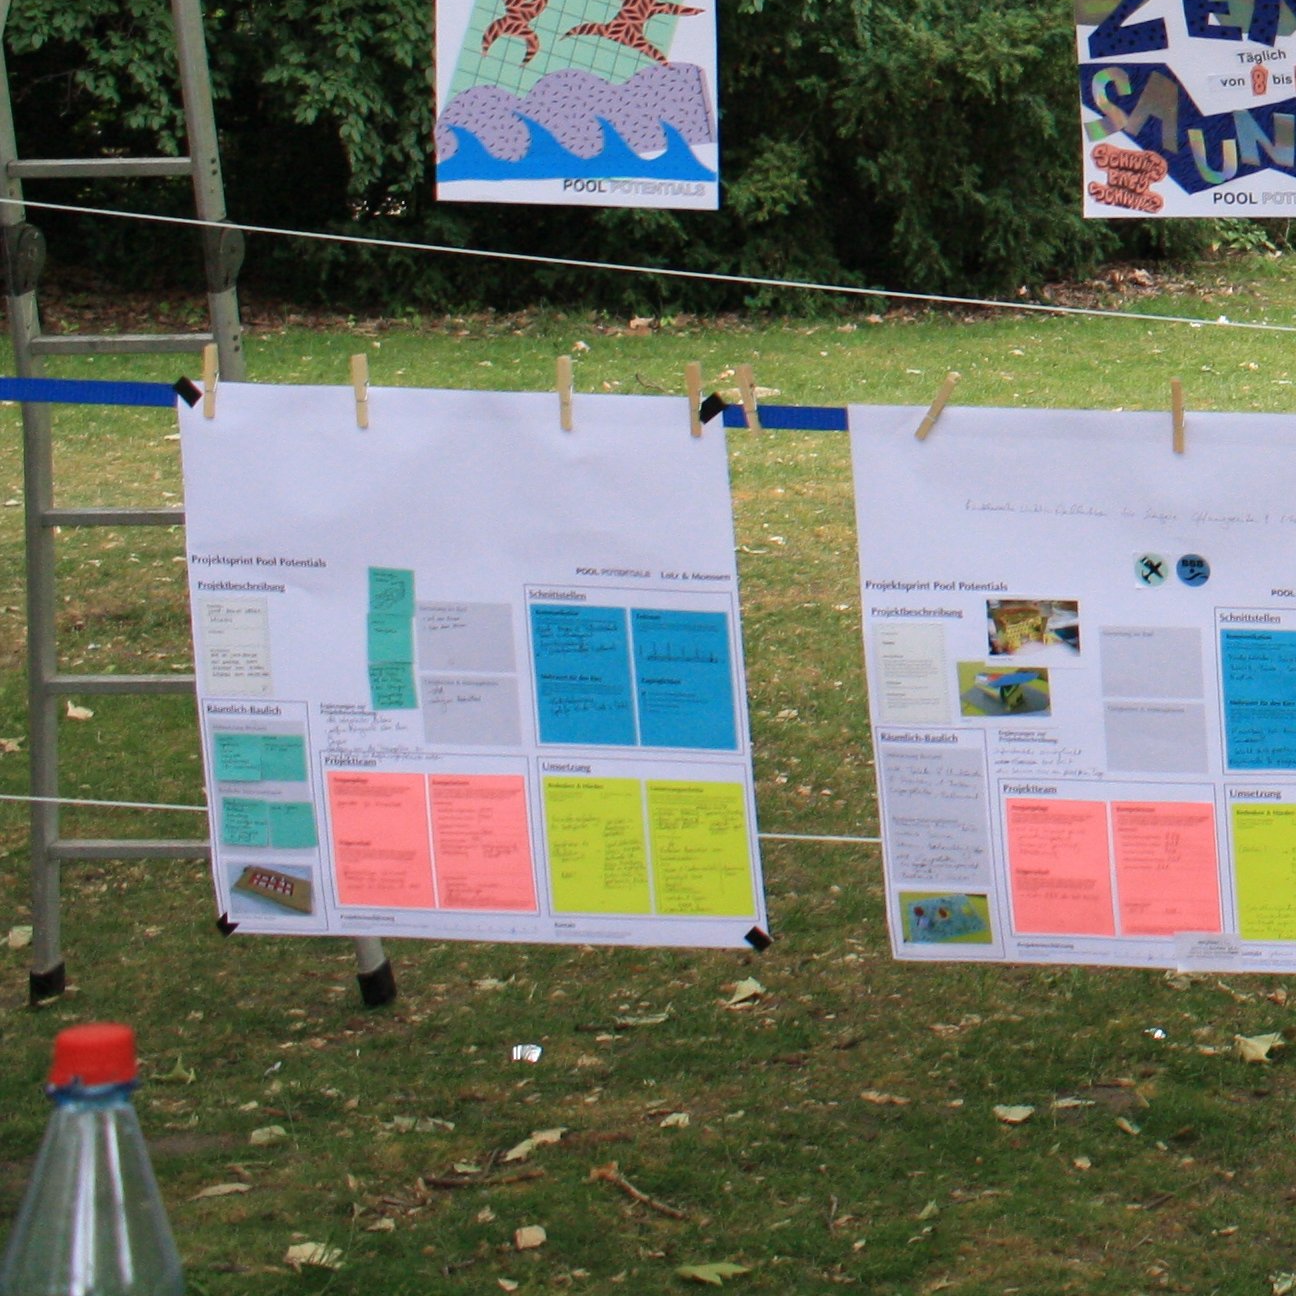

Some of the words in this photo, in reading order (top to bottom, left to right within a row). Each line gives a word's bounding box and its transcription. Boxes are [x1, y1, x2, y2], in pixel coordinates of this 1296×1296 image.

[1238, 49, 1287, 64] Täglich
[1220, 77, 1245, 88] von
[1251, 66, 1267, 95] 8
[1272, 71, 1292, 86] bis
[563, 179, 606, 194] POOL
[608, 181, 706, 197] POTENTIALS
[1213, 192, 1257, 204] POOL
[865, 580, 930, 592] Projektsprint
[933, 581, 955, 591] Pool
[959, 581, 1008, 591] Potentials
[1219, 612, 1281, 623] Schnittstellen
[1003, 784, 1057, 794] Projektteam
[1229, 789, 1281, 799] Umsetzung
